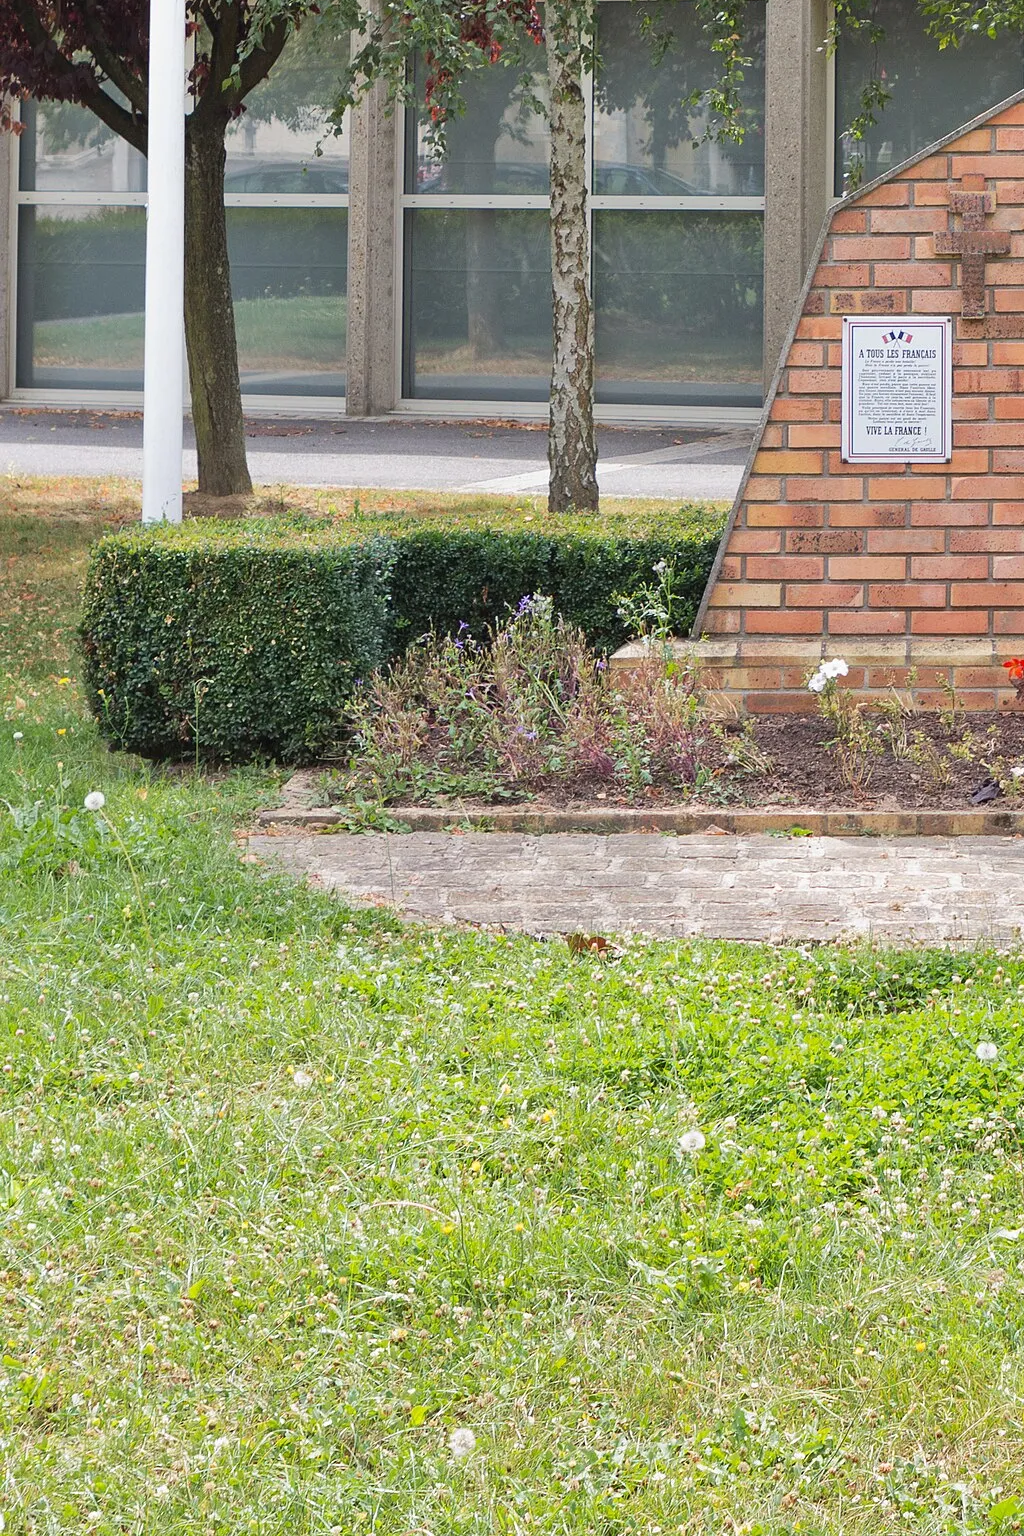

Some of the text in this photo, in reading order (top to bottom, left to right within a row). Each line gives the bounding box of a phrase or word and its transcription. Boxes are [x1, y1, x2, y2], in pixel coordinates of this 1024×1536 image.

[867, 349, 884, 358] TOUS
[887, 349, 899, 358] LES
[902, 349, 937, 359] FRANÇAIS
[866, 426, 882, 435] VIVE
[884, 426, 894, 435] LA
[894, 426, 922, 435] FRANCE
